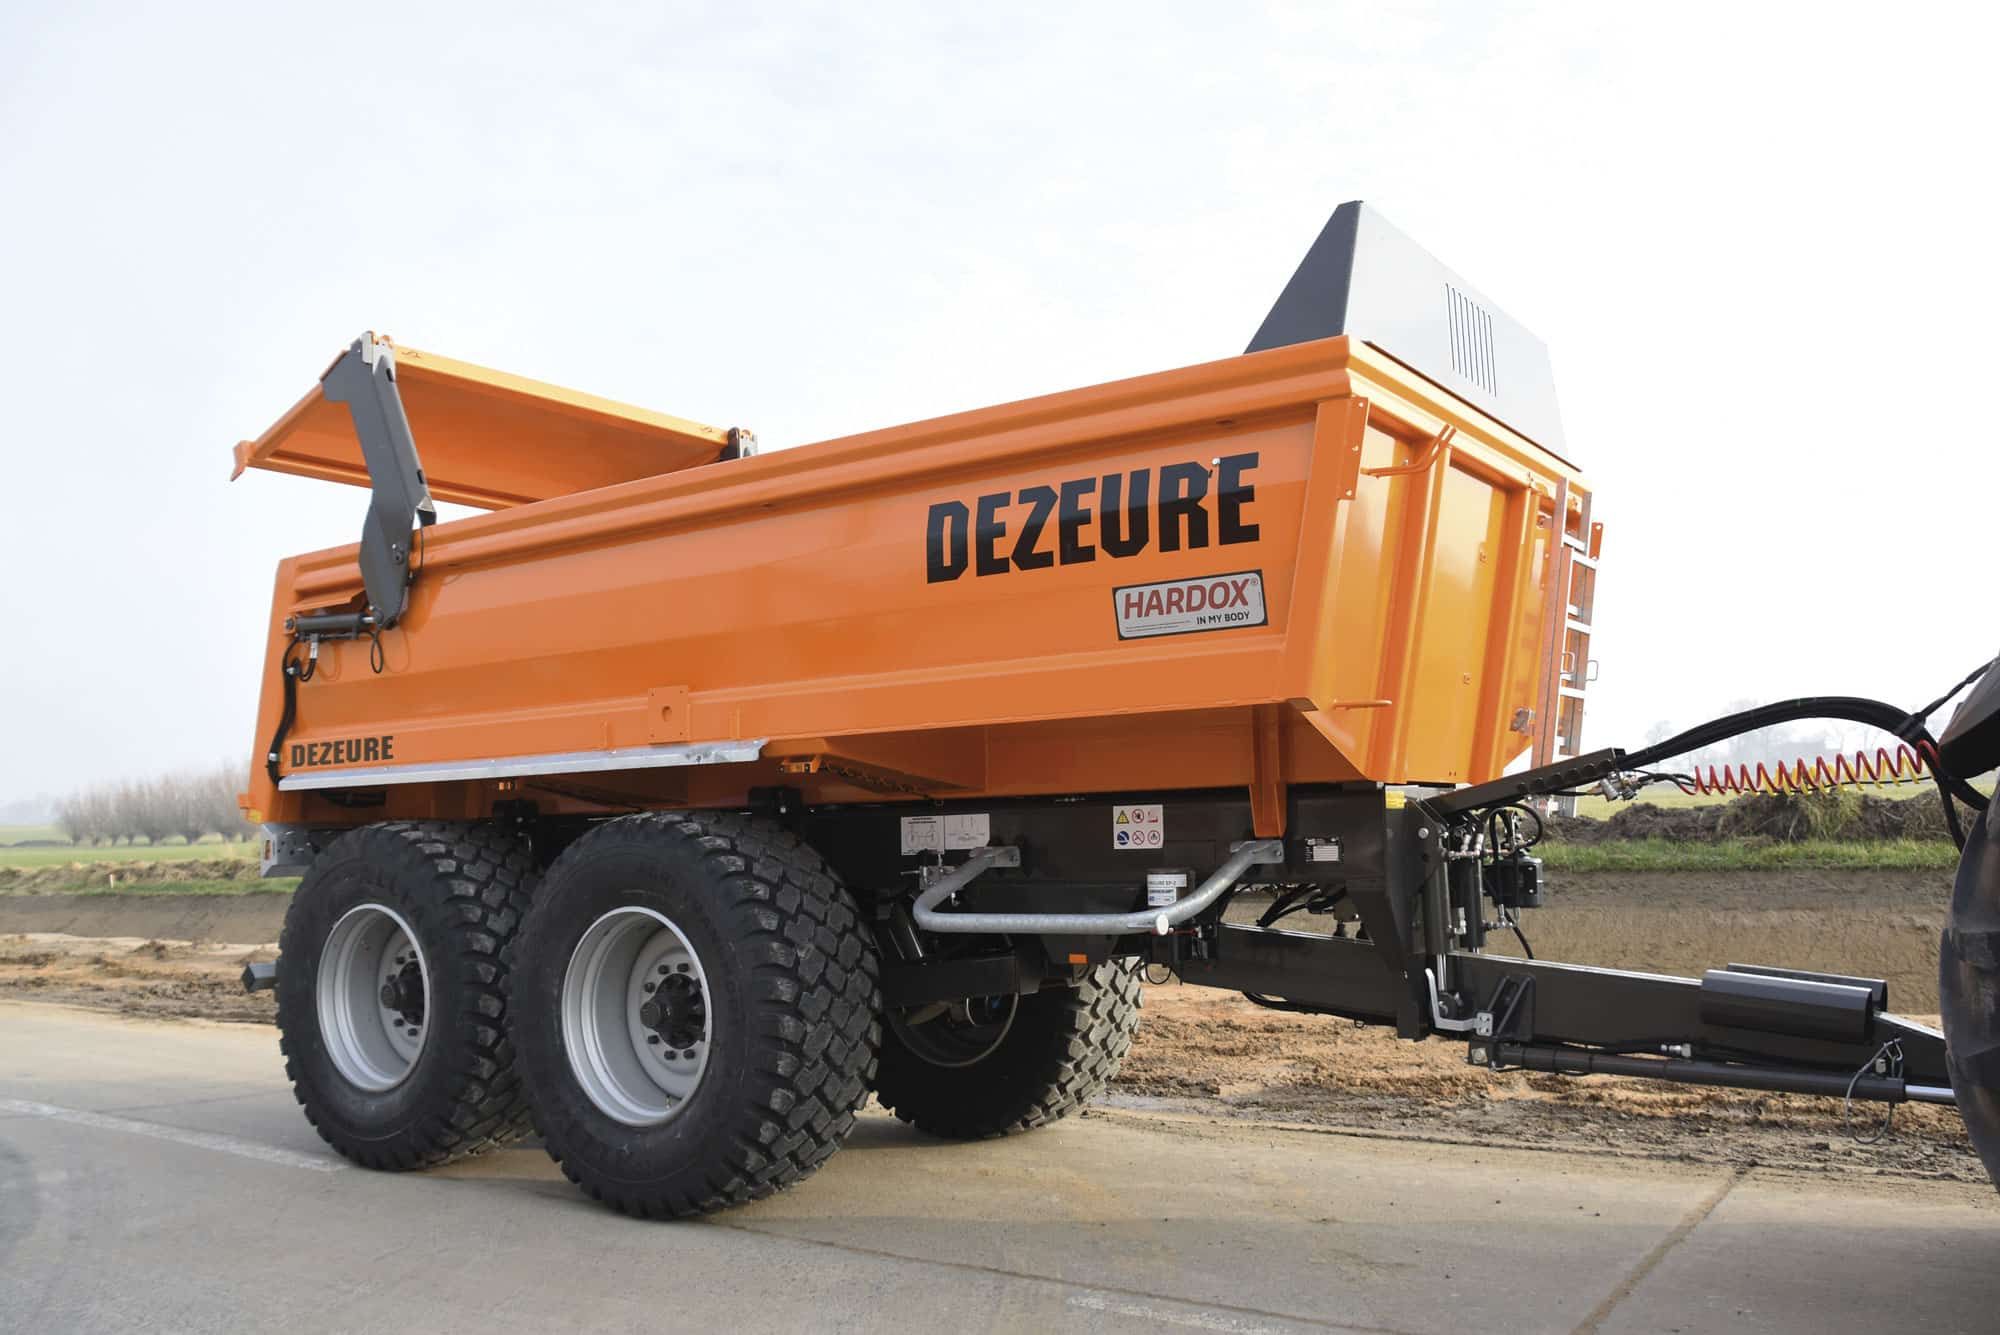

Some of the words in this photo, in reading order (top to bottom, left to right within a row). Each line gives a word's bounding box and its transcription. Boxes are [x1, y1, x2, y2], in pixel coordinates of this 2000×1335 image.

[926, 452, 1260, 584] DEZEURE
[1196, 615, 1206, 625] IN
[1208, 613, 1222, 624] MY
[1225, 611, 1250, 622] BODY
[291, 735, 394, 768] DEZEURE
